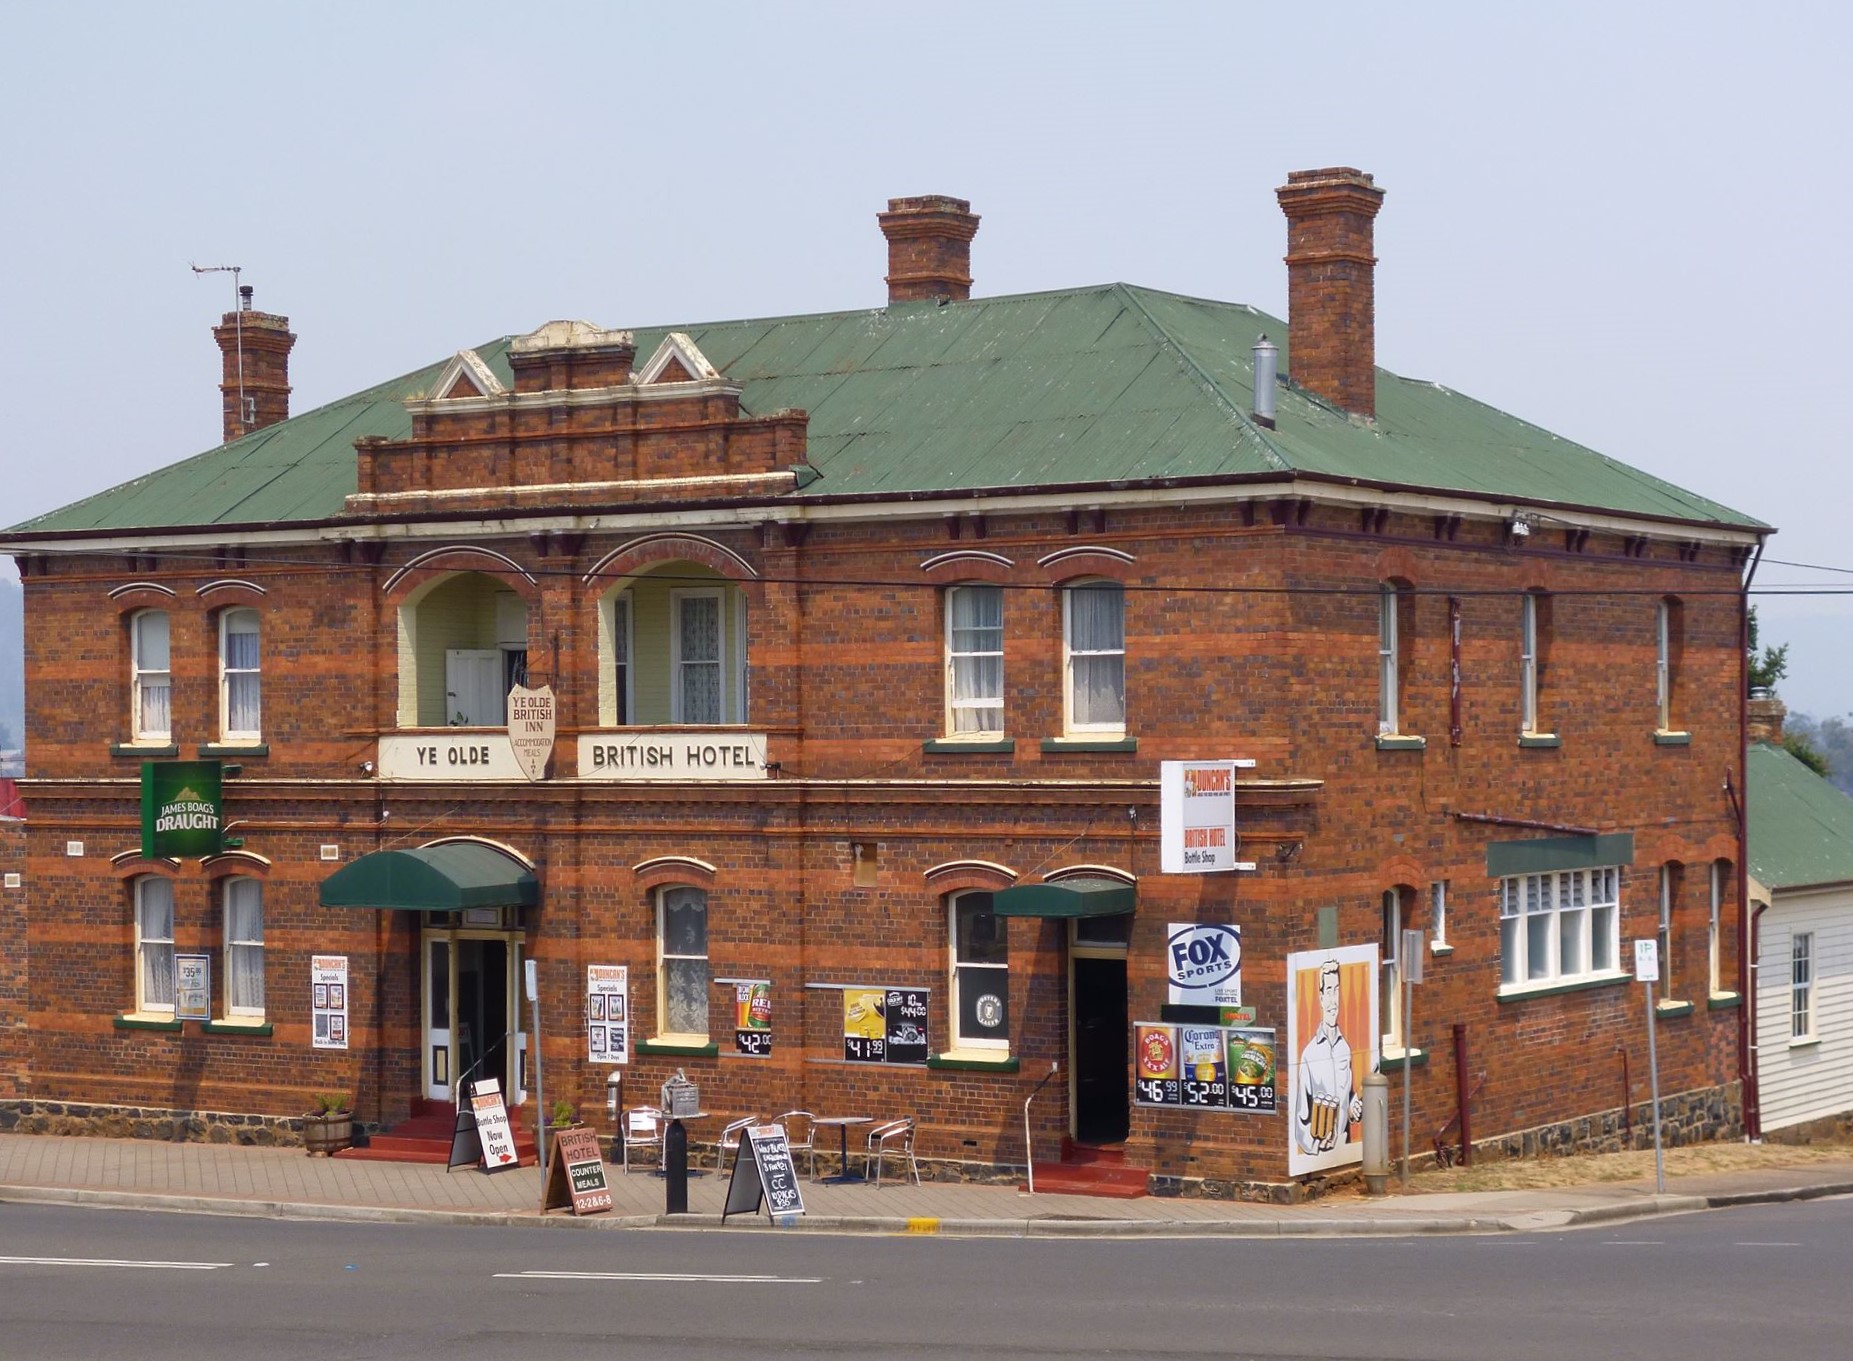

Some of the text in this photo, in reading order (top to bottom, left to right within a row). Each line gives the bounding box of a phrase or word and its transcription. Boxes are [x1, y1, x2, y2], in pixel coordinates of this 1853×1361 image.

[513, 697, 551, 708] YE OLDE
[514, 709, 552, 720] BRITISH
[525, 721, 544, 732] INN
[514, 738, 552, 747] ACCOMMODATION
[417, 746, 490, 765] YE OLDE
[524, 749, 541, 757] MEALS
[593, 745, 755, 766] BRITISH HOTEL
[1197, 769, 1231, 791] DUNCAN'S
[161, 802, 214, 818] JAMES BOAG'S
[156, 813, 219, 832] DRAUGHT
[1185, 828, 1226, 848] BRITISH HOTEL
[1185, 850, 1216, 865] Bottle Shop
[1172, 932, 1230, 971] FOX
[1177, 960, 1232, 980] SPORTS
[320, 973, 339, 982] Specials
[597, 984, 618, 992] Specials
[1145, 1033, 1169, 1046] BOAG'S
[1195, 1041, 1215, 1051] Extra
[1143, 1055, 1158, 1072] XXX
[1138, 1080, 1178, 1102] $46.99
[1184, 1082, 1225, 1104] $52.00
[1231, 1085, 1273, 1108] $45.00
[477, 1114, 507, 1127] Bottle Shop
[487, 1130, 503, 1142] Now
[561, 1132, 597, 1147] BRITISH
[490, 1144, 508, 1157] Open
[566, 1147, 598, 1160] HOTEL
[571, 1164, 602, 1177] COUNTER
[763, 1163, 769, 1172] 3
[576, 1178, 600, 1189] MEALS
[771, 1178, 787, 1190] CC
